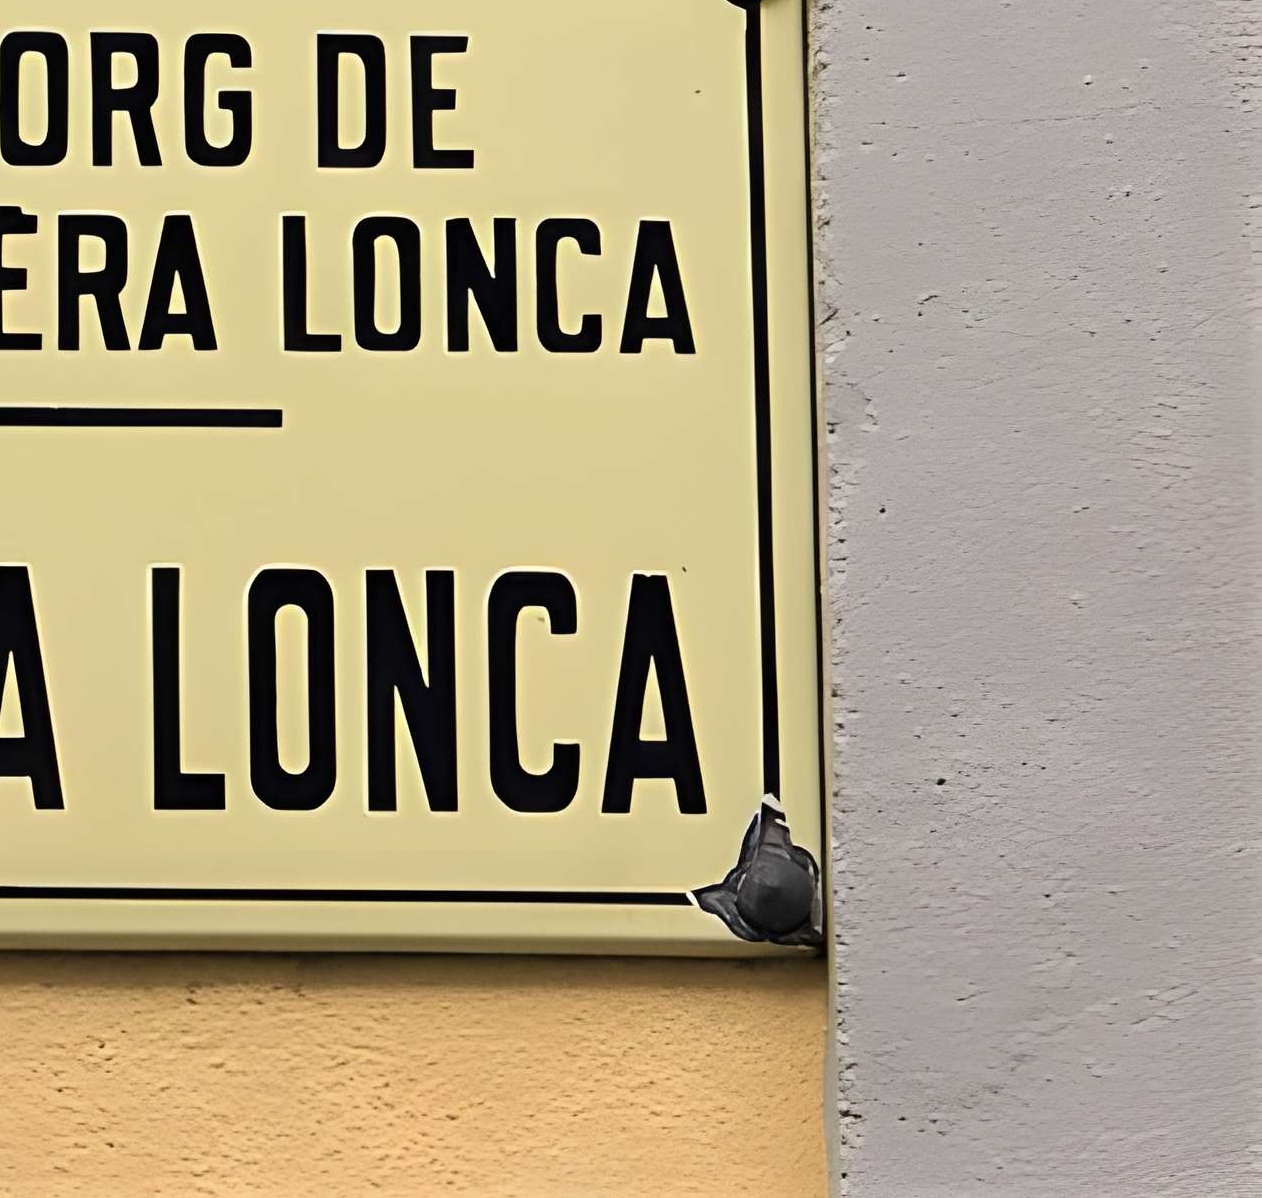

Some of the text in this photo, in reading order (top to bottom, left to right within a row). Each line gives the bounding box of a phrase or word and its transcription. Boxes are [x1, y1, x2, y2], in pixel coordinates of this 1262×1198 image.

[316, 32, 476, 170] DE
[282, 214, 698, 356] LONCA
[151, 567, 708, 815] LONCA
